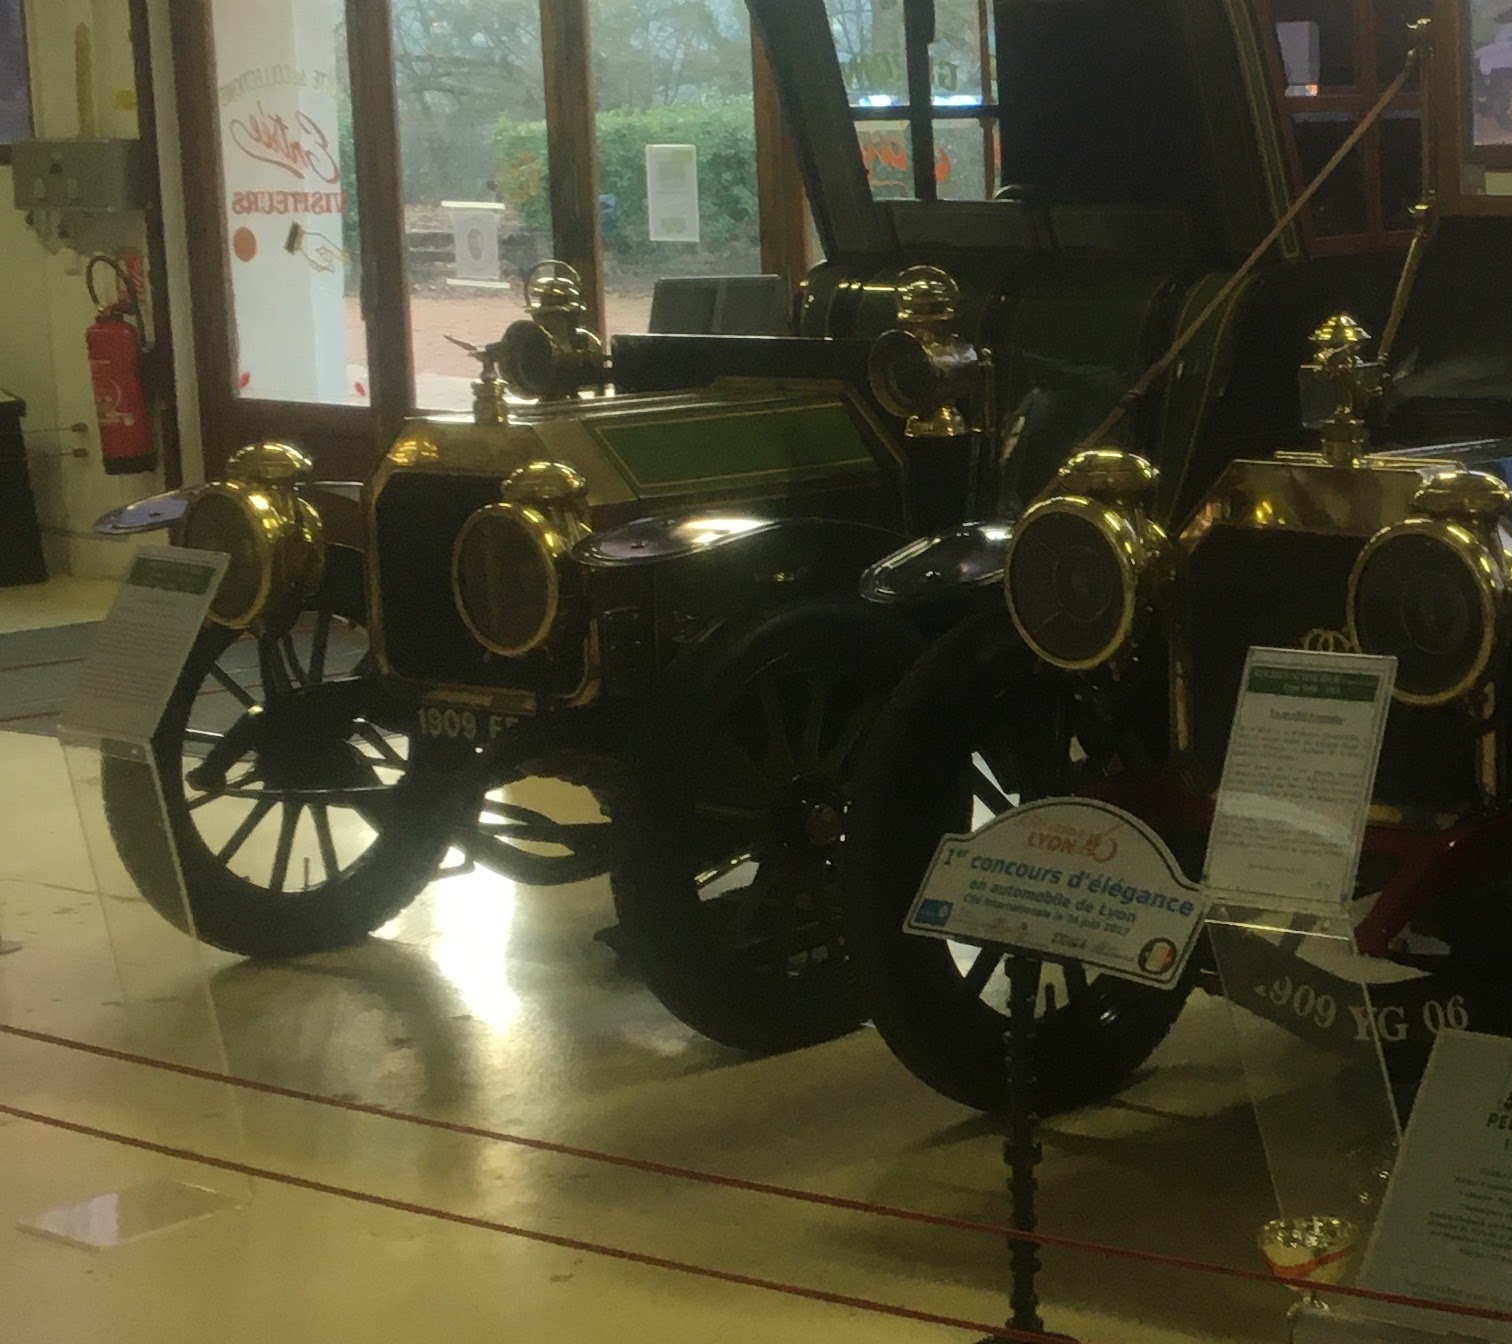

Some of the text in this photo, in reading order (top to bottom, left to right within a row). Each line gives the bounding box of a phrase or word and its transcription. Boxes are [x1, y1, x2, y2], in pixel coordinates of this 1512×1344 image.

[418, 706, 477, 740] 1909
[1027, 831, 1078, 856] LYON
[969, 879, 1137, 923] en automobile de Lyon
[970, 853, 1063, 885] concours
[1067, 869, 1195, 918] d'élégance
[1348, 1005, 1409, 1042] YG
[1423, 994, 1469, 1035] 06
